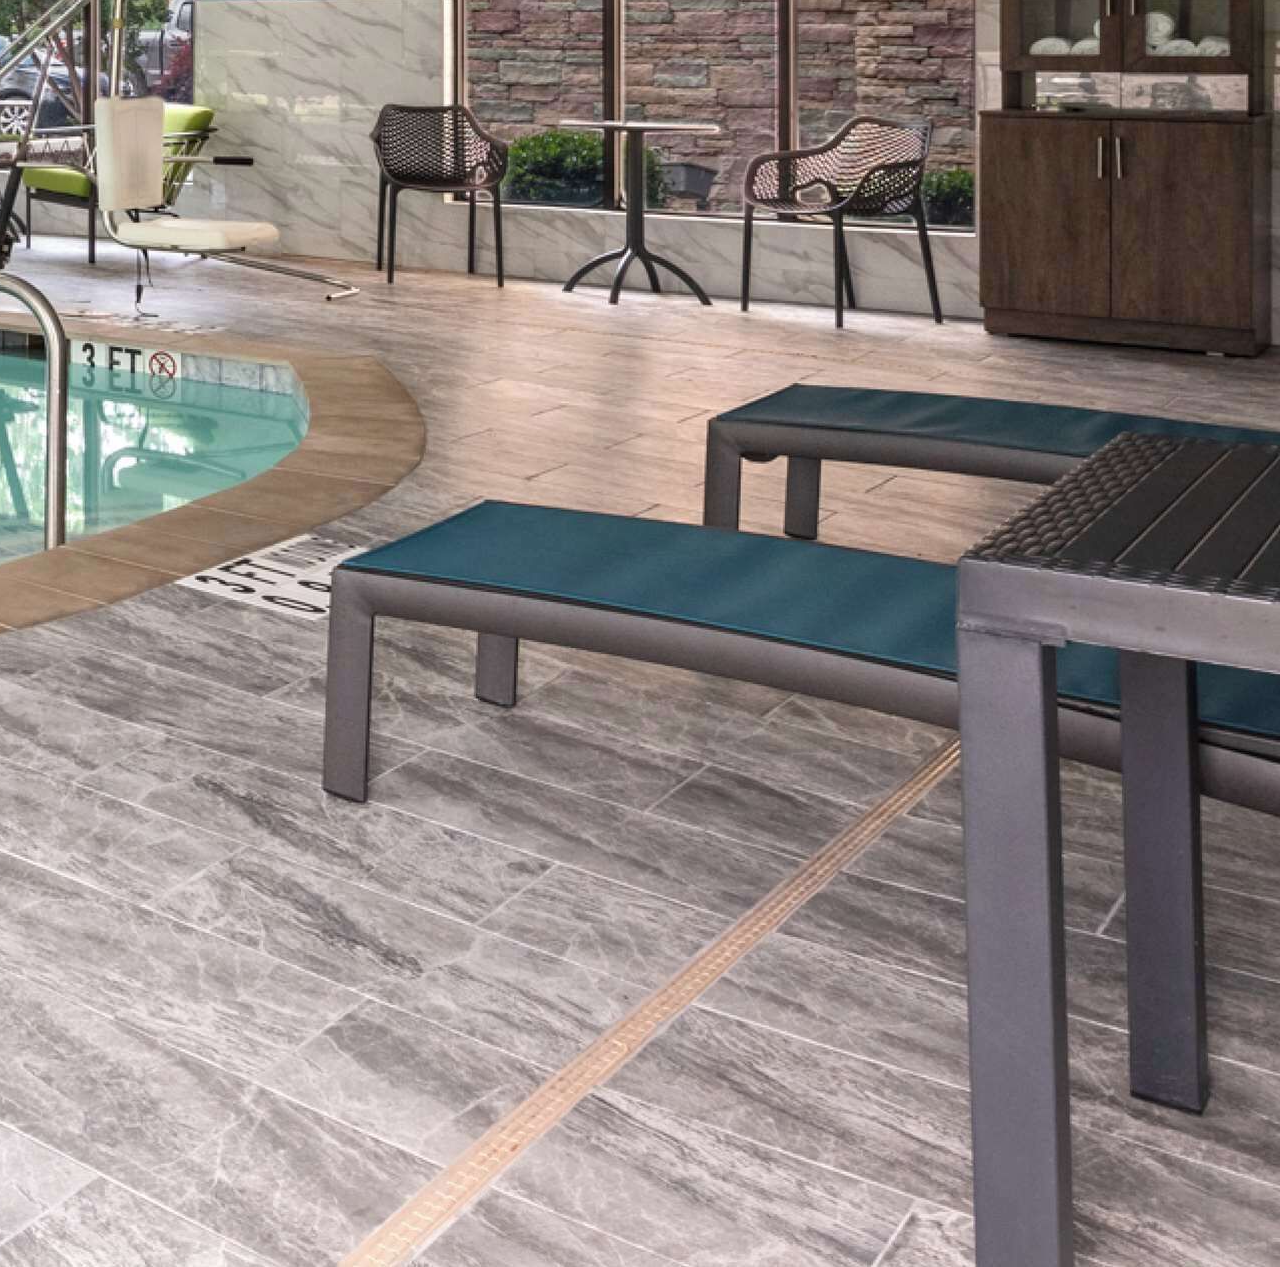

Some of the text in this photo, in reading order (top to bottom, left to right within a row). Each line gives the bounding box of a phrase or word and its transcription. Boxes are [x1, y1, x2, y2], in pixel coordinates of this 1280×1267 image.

[82, 342, 142, 374] 3 FT
[217, 558, 296, 586] FT
